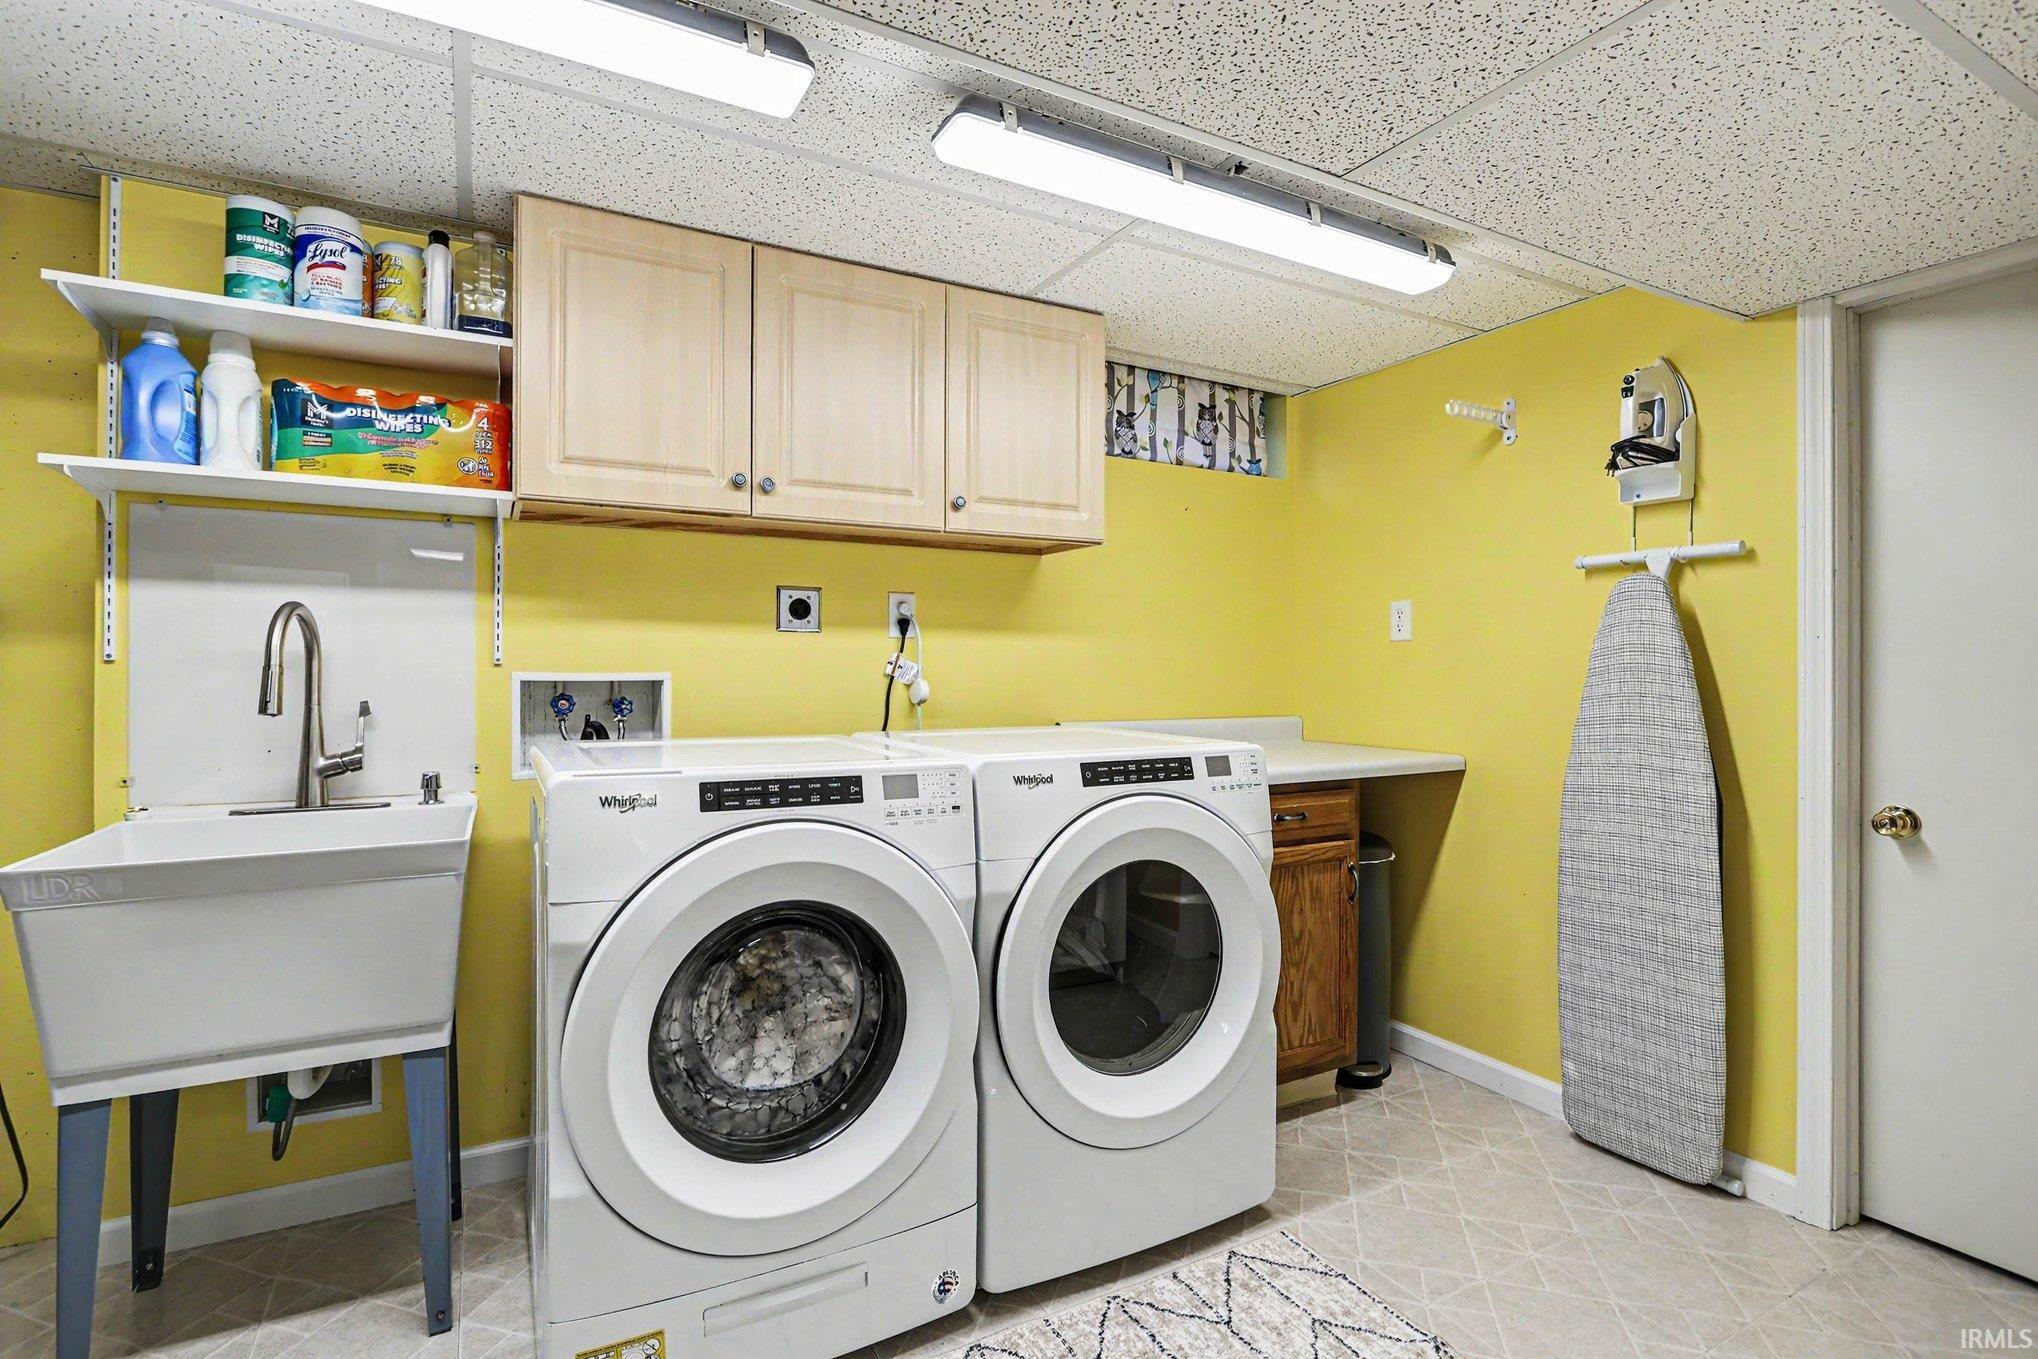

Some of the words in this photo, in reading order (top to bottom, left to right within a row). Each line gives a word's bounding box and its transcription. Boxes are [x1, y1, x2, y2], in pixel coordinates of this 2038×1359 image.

[308, 242, 348, 263] Lysol
[346, 407, 451, 428] DISINFECTING
[476, 416, 490, 431] 4
[374, 420, 424, 433] WIPES
[474, 439, 493, 449] 312
[1013, 773, 1054, 789] Whirlpool
[599, 794, 658, 814] Whirlpool
